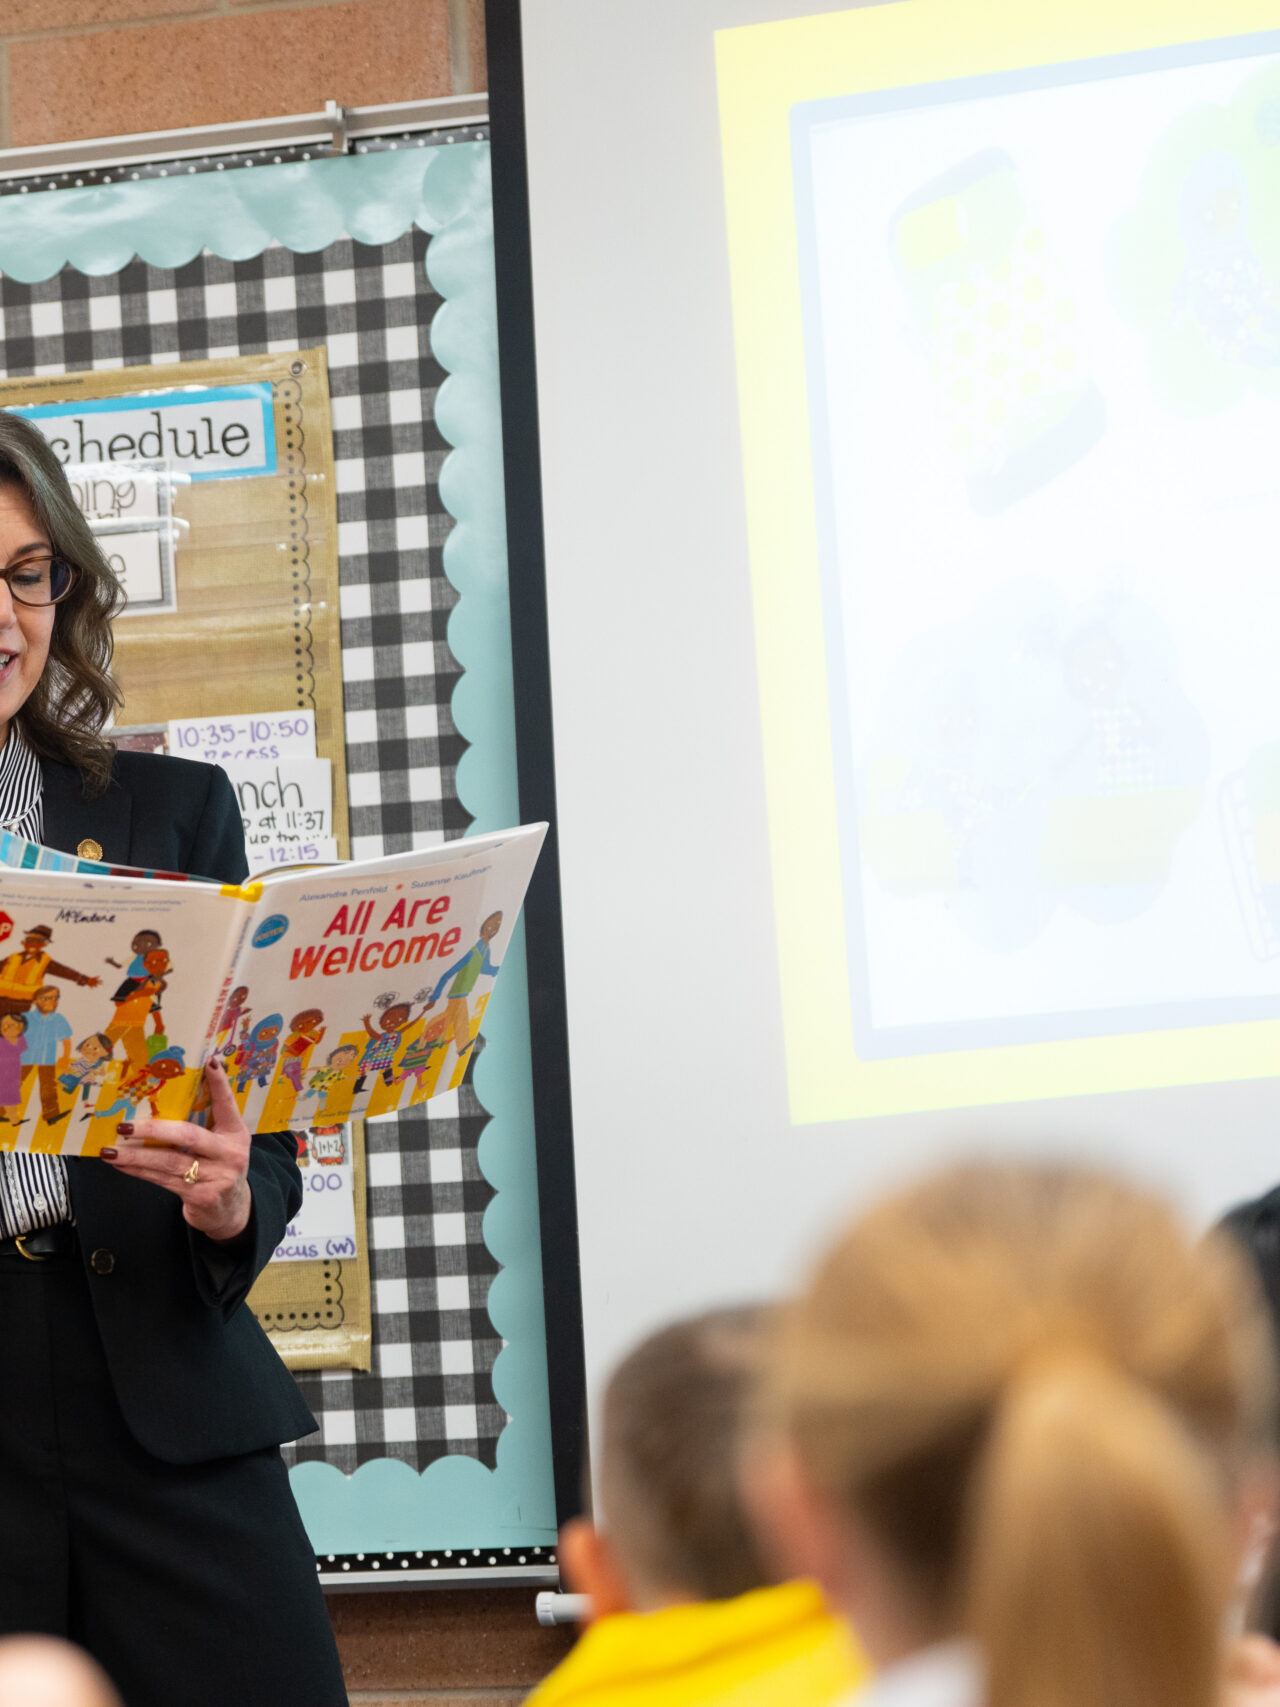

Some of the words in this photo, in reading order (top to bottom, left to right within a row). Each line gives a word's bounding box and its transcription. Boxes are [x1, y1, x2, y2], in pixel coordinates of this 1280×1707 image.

[49, 411, 251, 464] chedule
[235, 765, 304, 812] nch
[351, 885, 389, 897] Penfold
[410, 876, 452, 889] Suzanne
[322, 900, 377, 938] All
[380, 895, 452, 932] Are
[289, 926, 462, 981] Welcome
[274, 1244, 319, 1258] ocus
